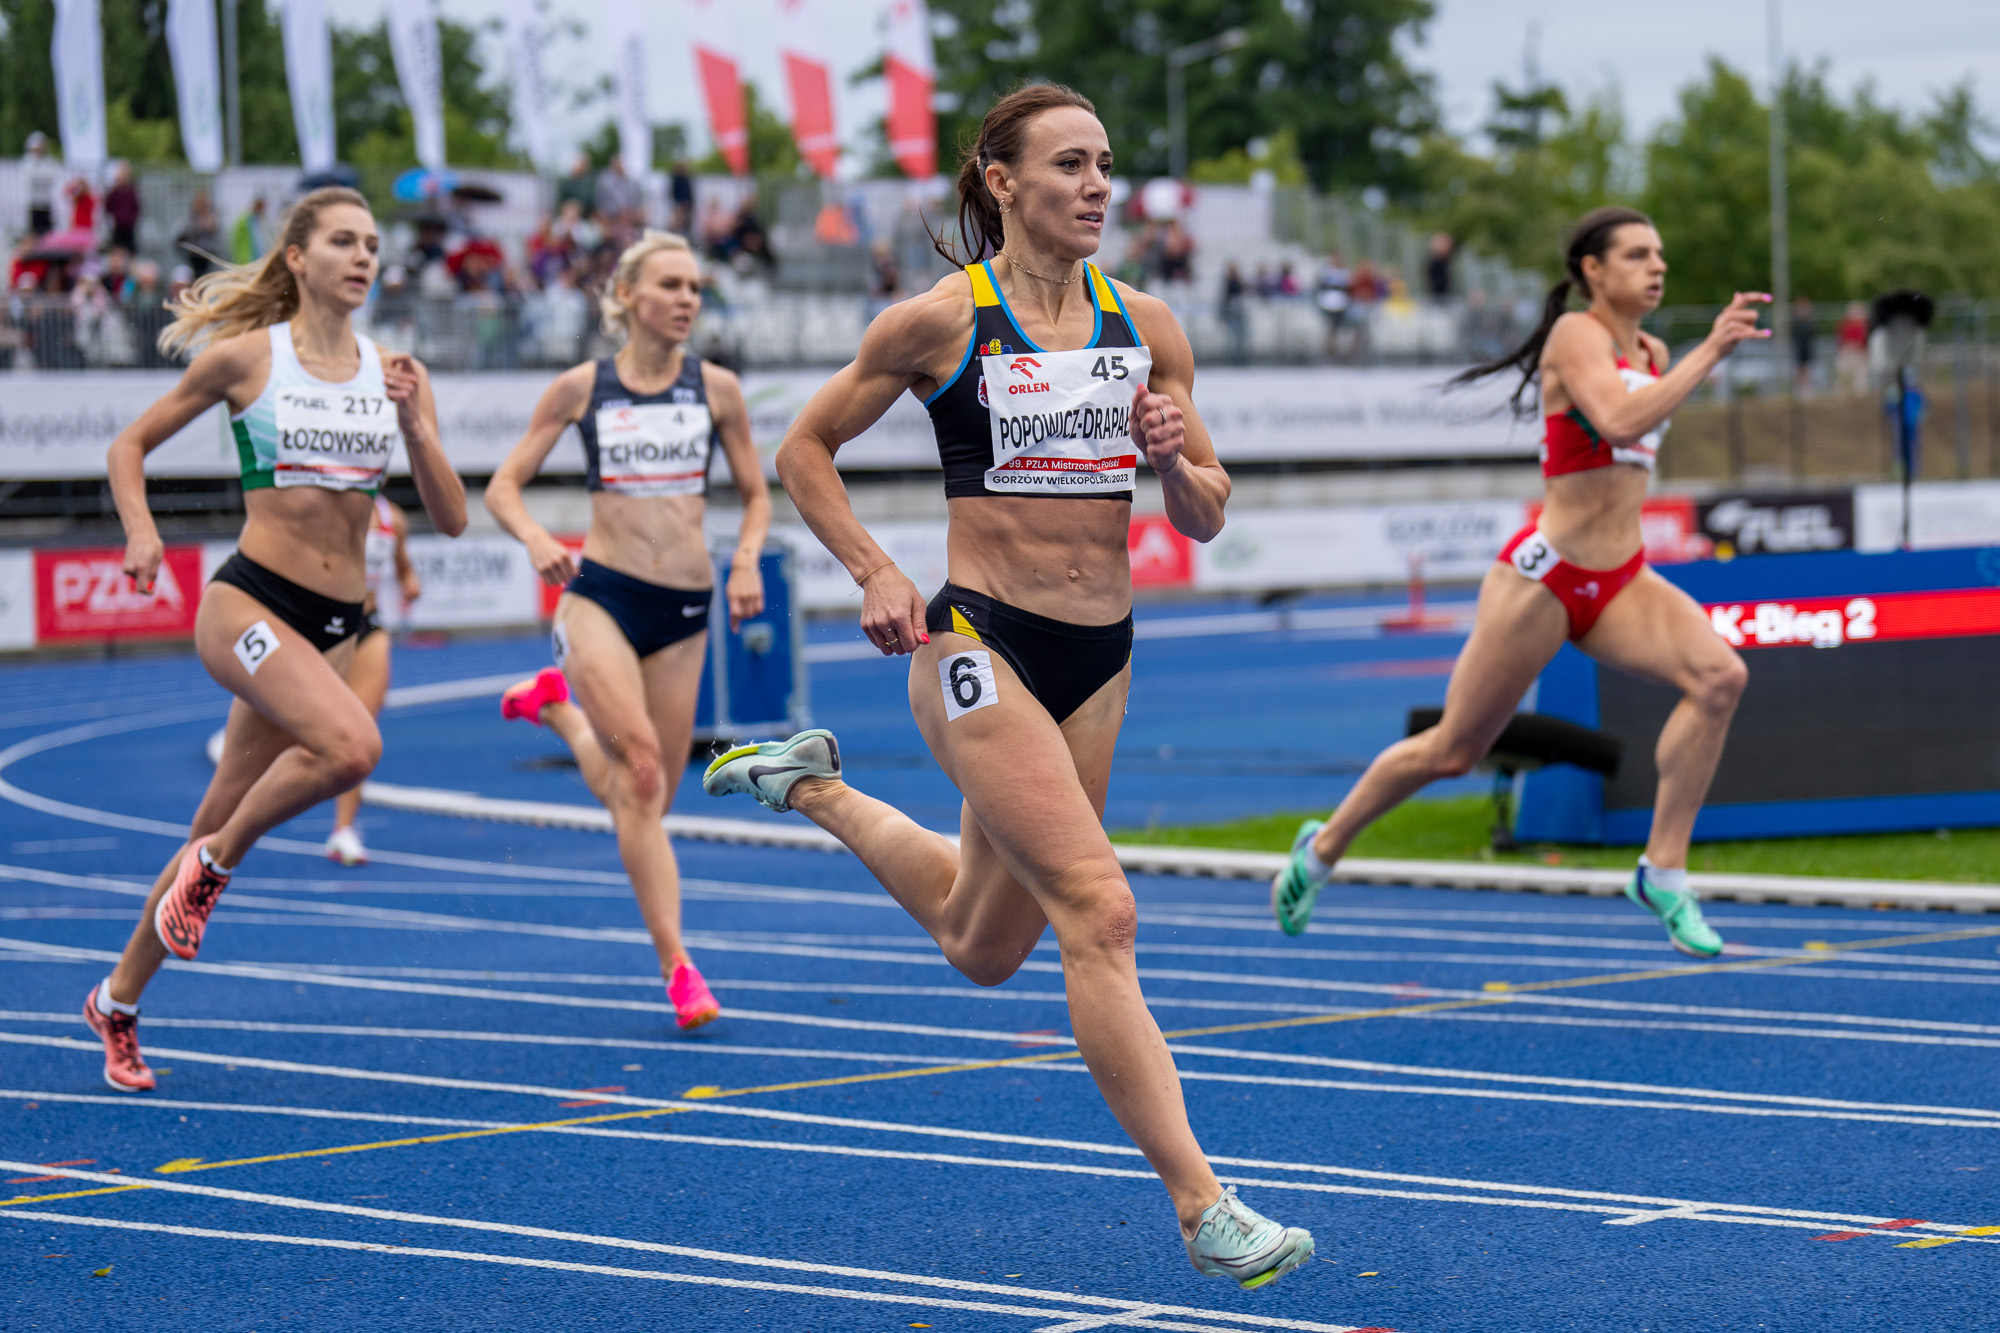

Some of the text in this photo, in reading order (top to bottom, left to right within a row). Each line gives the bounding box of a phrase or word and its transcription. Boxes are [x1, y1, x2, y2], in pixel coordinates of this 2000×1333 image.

[1091, 355, 1129, 381] 45
[1008, 382, 1050, 395] ORLEN
[344, 395, 383, 415] 217
[672, 410, 685, 425] 4
[282, 428, 389, 455] ŁOZOWSKA
[609, 441, 699, 464] CHOJKA
[1008, 459, 1024, 468] 99.
[1026, 459, 1049, 469] PZLA
[1101, 458, 1120, 469] Polski
[992, 473, 1044, 485] GORZÓW
[1111, 473, 1129, 483] 2023
[1520, 543, 1547, 571] 3
[1844, 598, 1878, 639] 2
[243, 629, 267, 662] 5
[949, 656, 982, 709] 6
